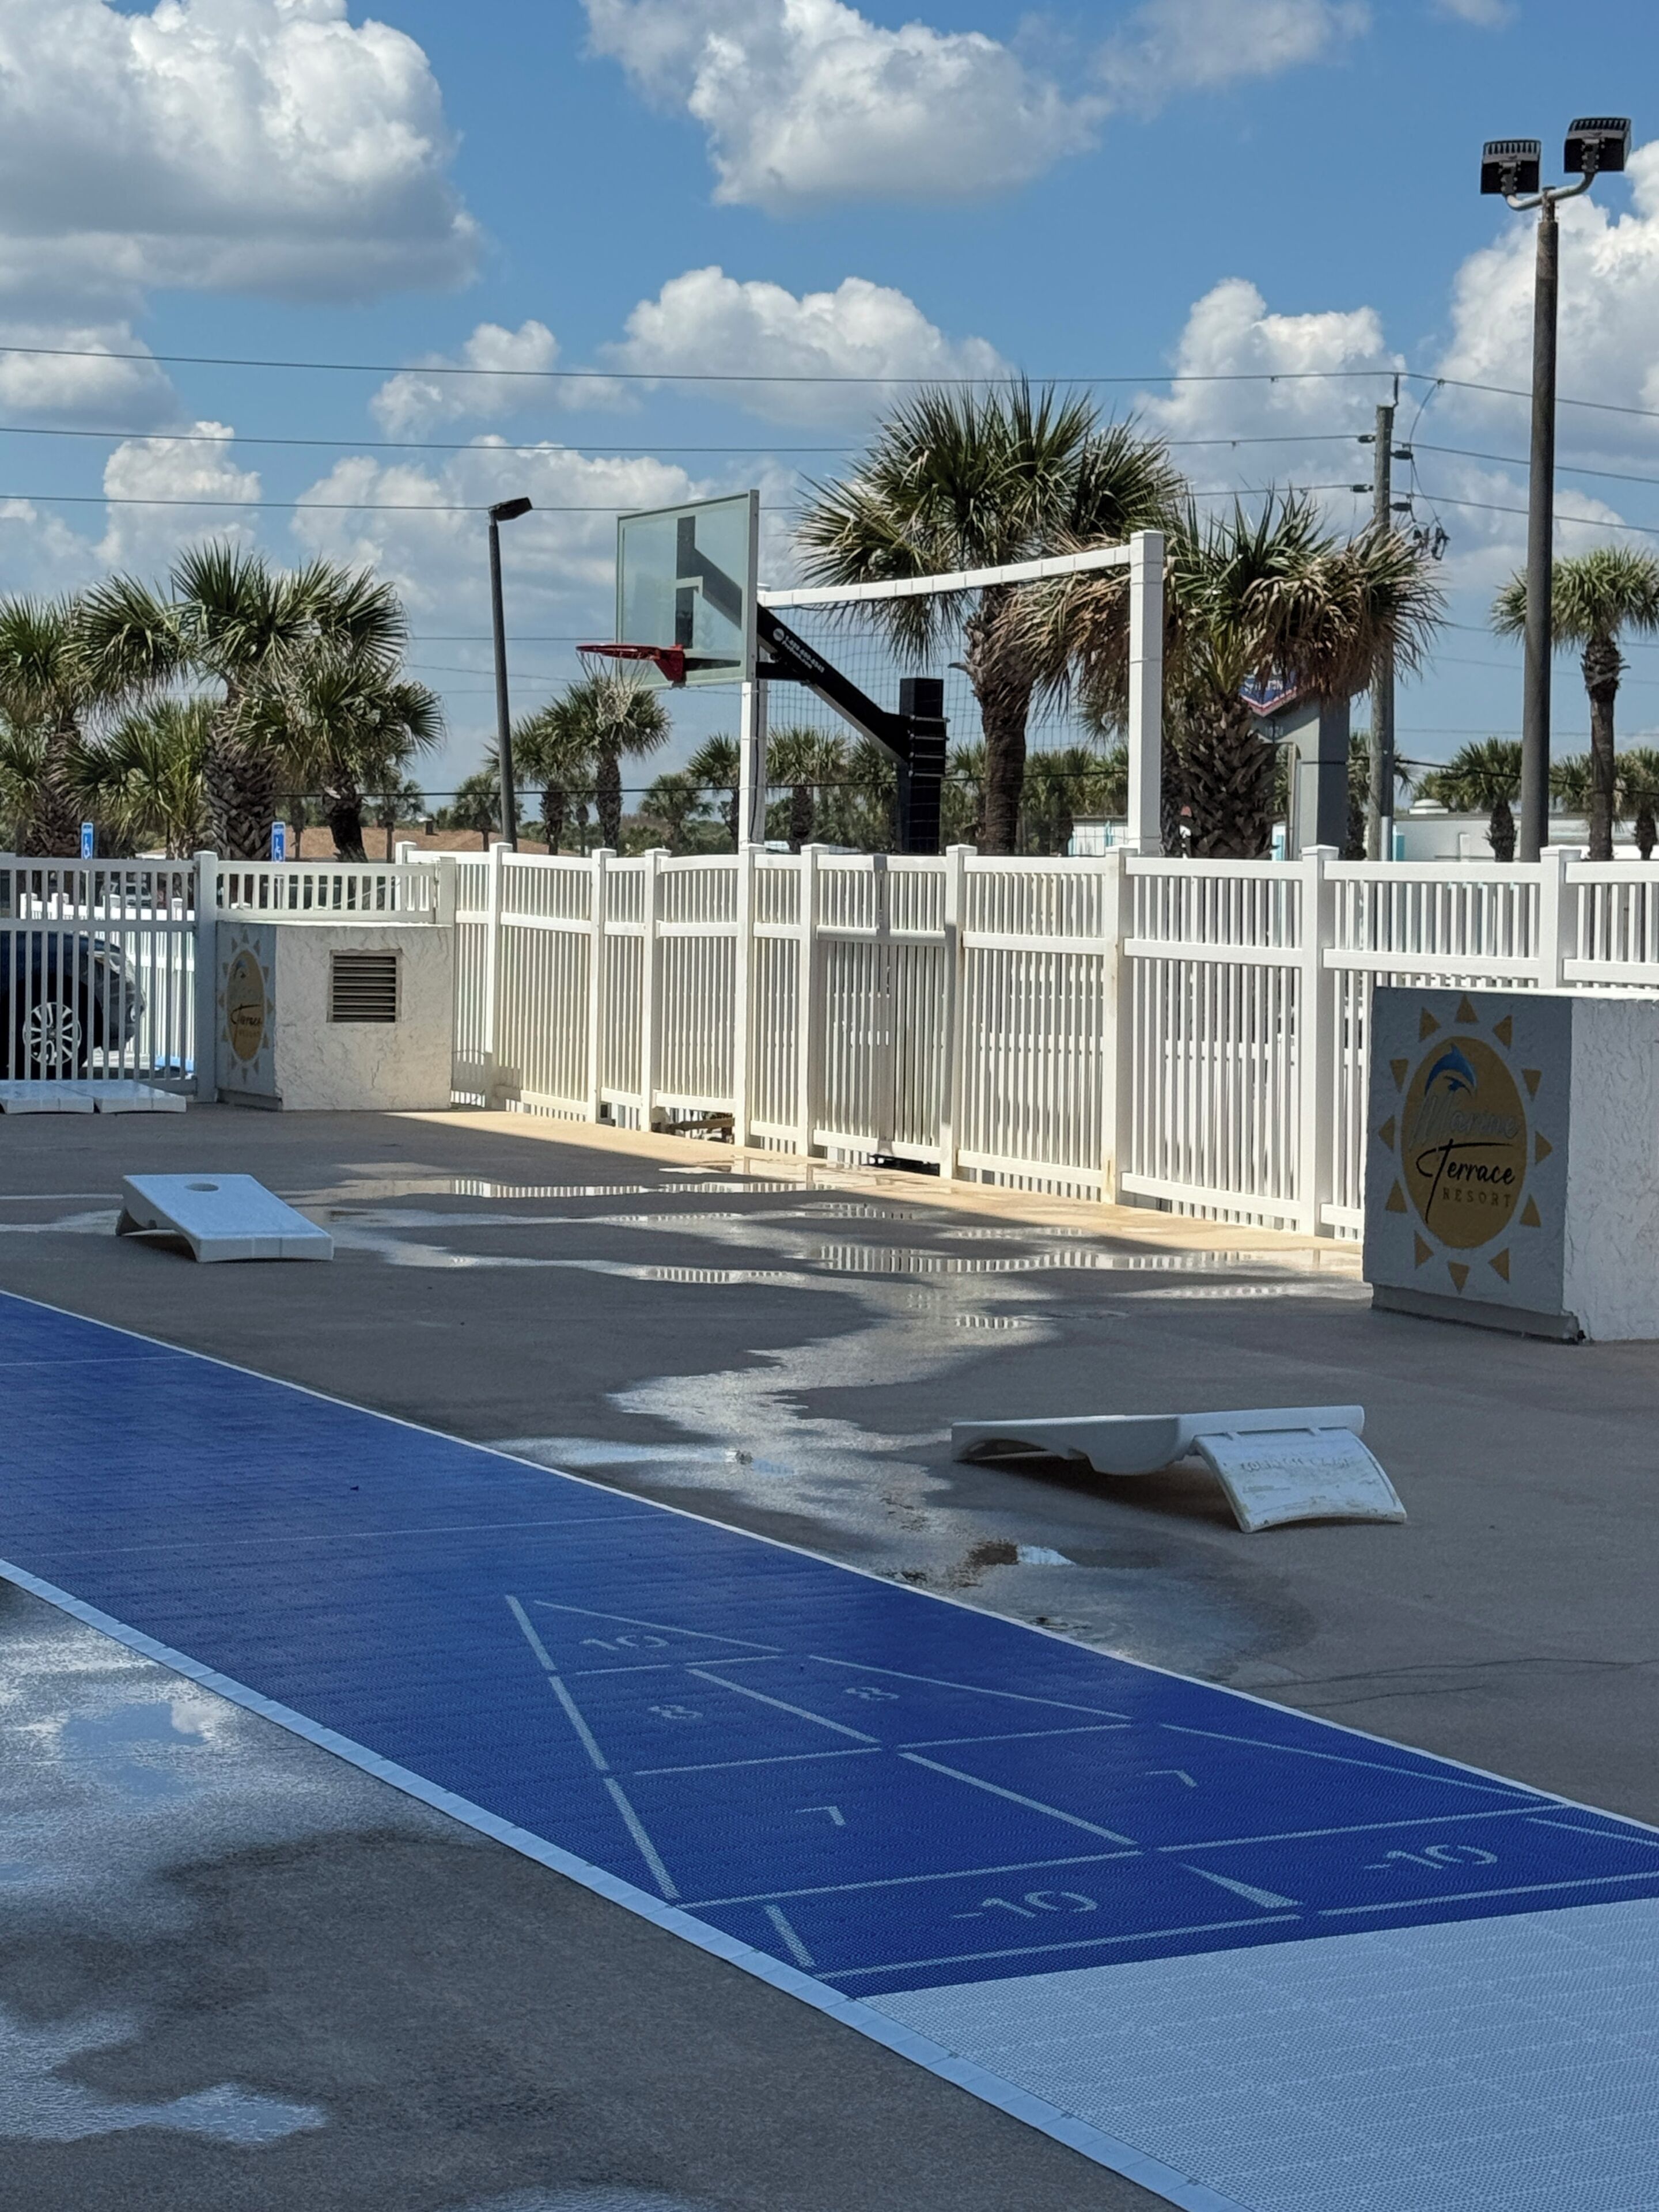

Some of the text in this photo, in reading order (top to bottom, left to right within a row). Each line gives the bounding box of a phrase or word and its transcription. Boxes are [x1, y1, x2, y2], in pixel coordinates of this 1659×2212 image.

[1416, 1138, 1516, 1224] Terrace
[1442, 1187, 1511, 1208] RESORT
[578, 1635, 669, 1650] 10
